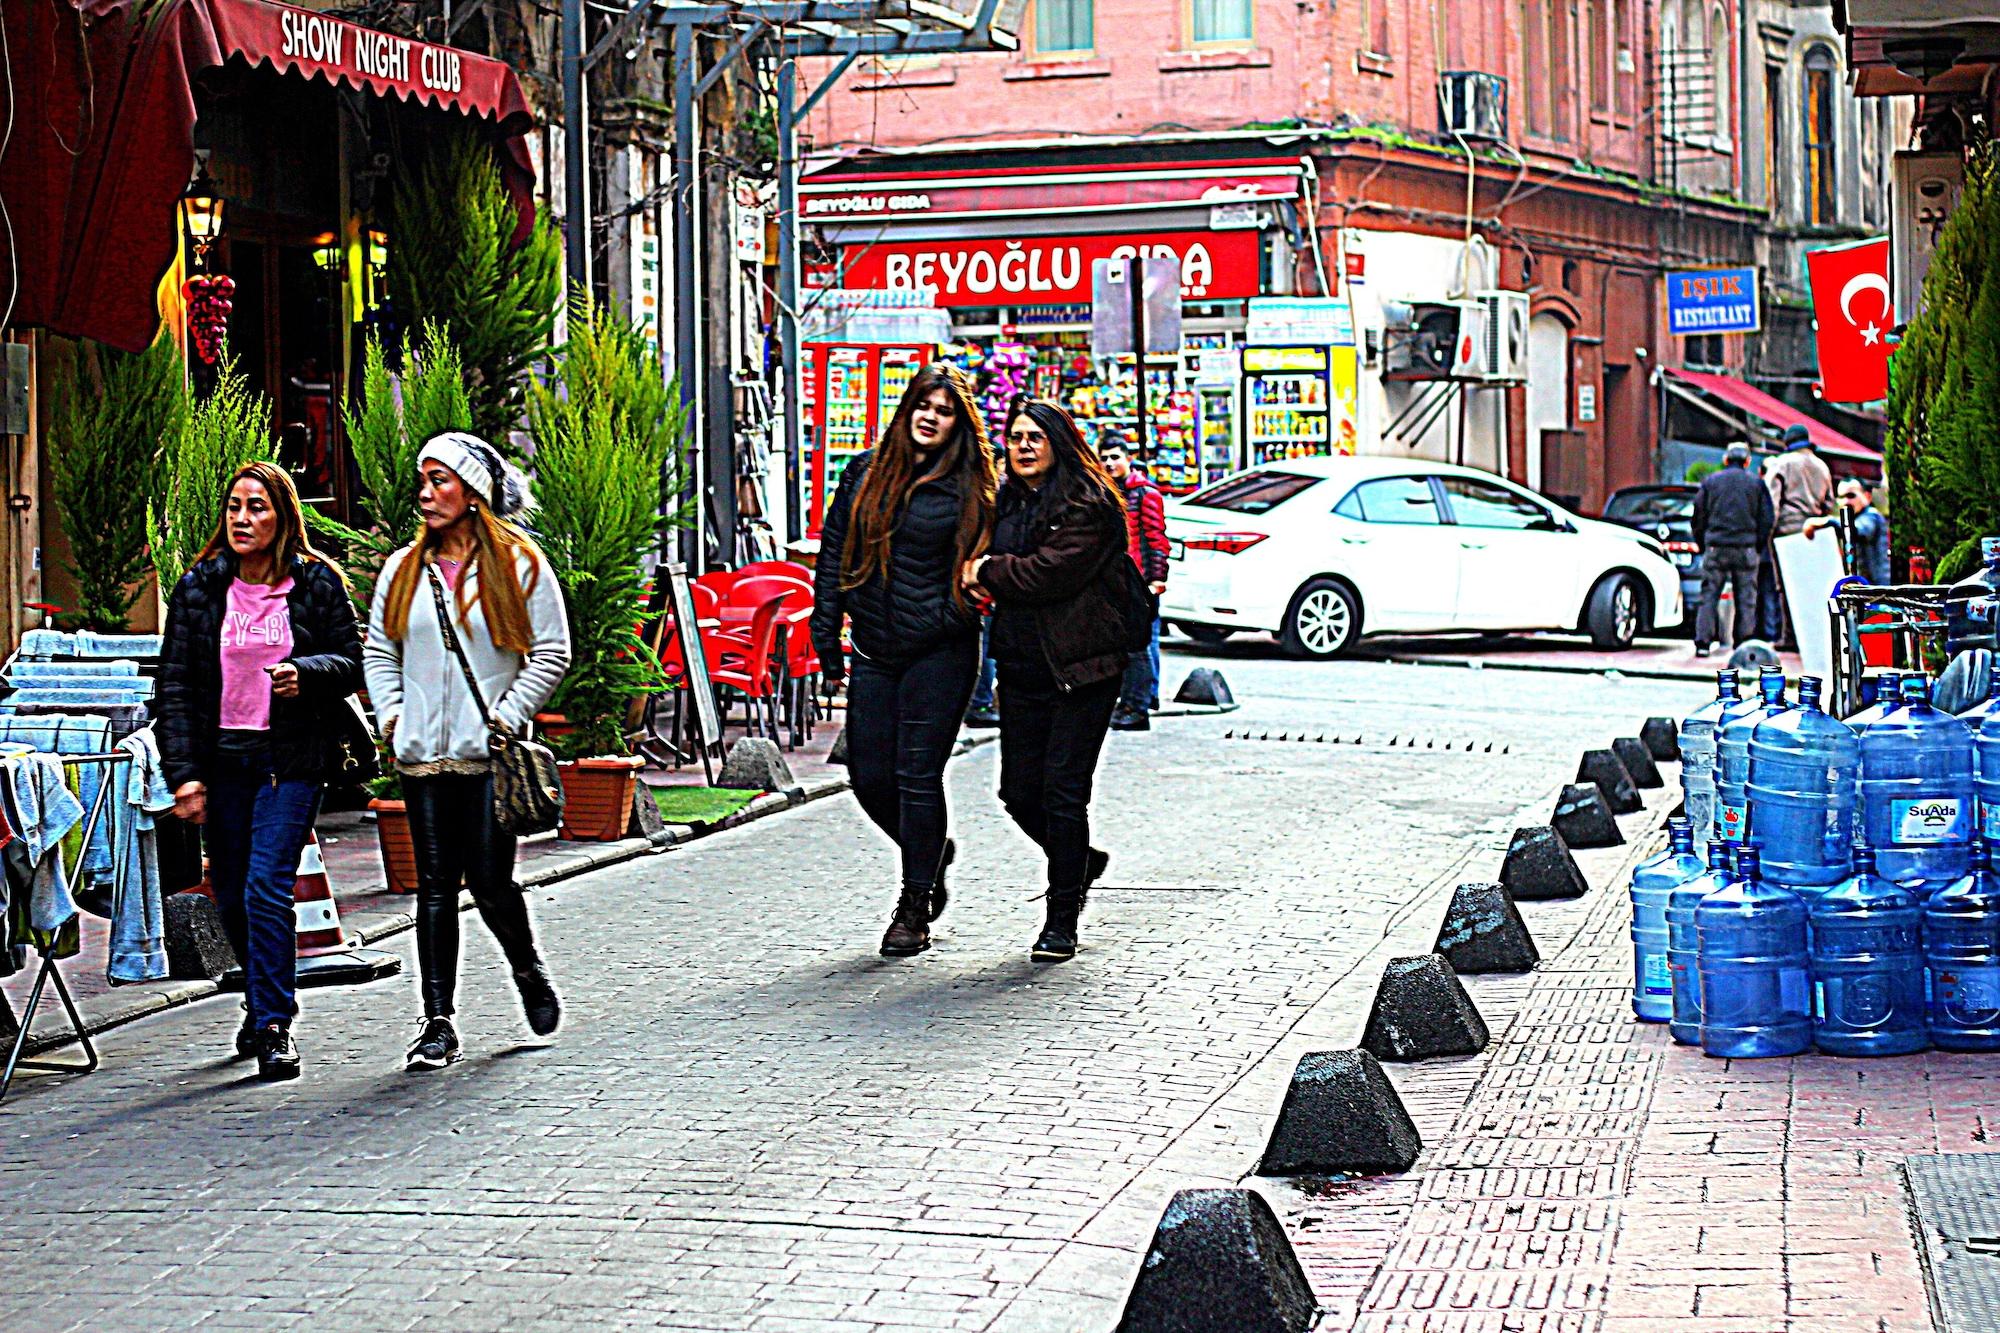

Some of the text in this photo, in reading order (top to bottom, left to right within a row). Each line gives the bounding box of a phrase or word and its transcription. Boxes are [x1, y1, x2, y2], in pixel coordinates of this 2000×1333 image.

[281, 9, 461, 93] SHOW NIGHT CLUB
[885, 240, 1081, 295] BEYOĞLU
[1681, 276, 1742, 302] IŞIK
[1674, 304, 1751, 327] RESTAURANT
[1909, 805, 1956, 817] SuAda
